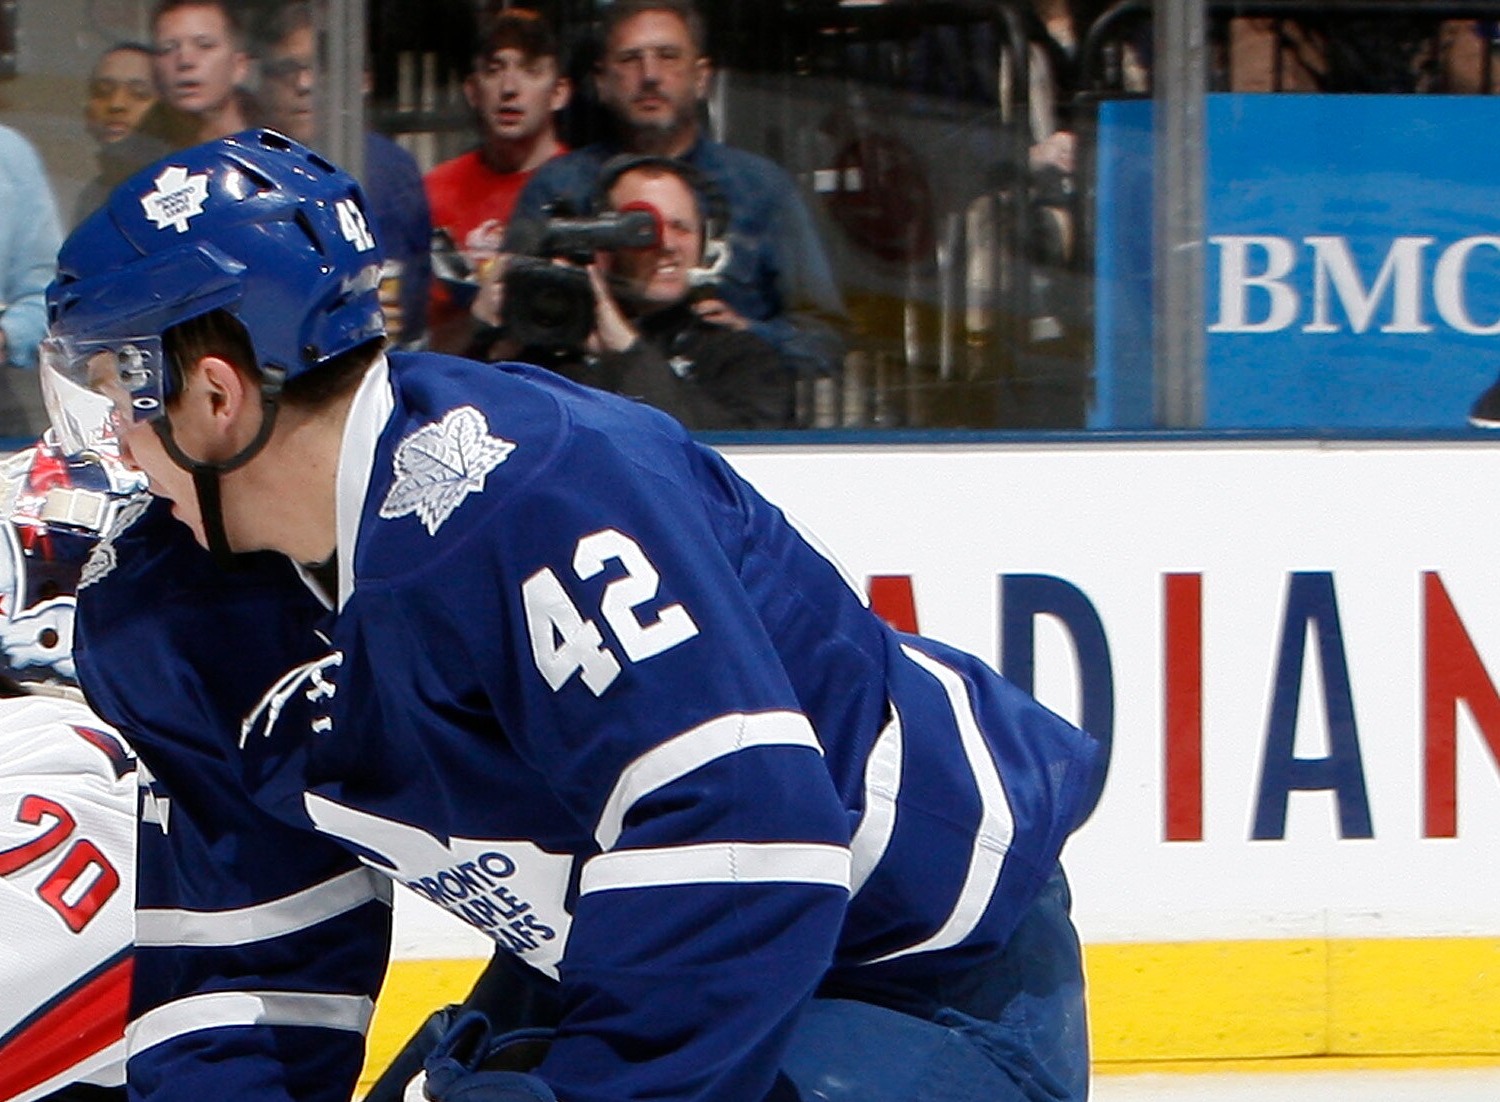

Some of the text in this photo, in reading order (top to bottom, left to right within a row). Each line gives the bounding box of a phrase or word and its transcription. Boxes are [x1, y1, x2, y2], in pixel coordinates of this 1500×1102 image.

[335, 199, 376, 252] 42
[522, 527, 700, 697] 42
[870, 571, 1500, 841] DIAN
[459, 886, 532, 927] APLE
